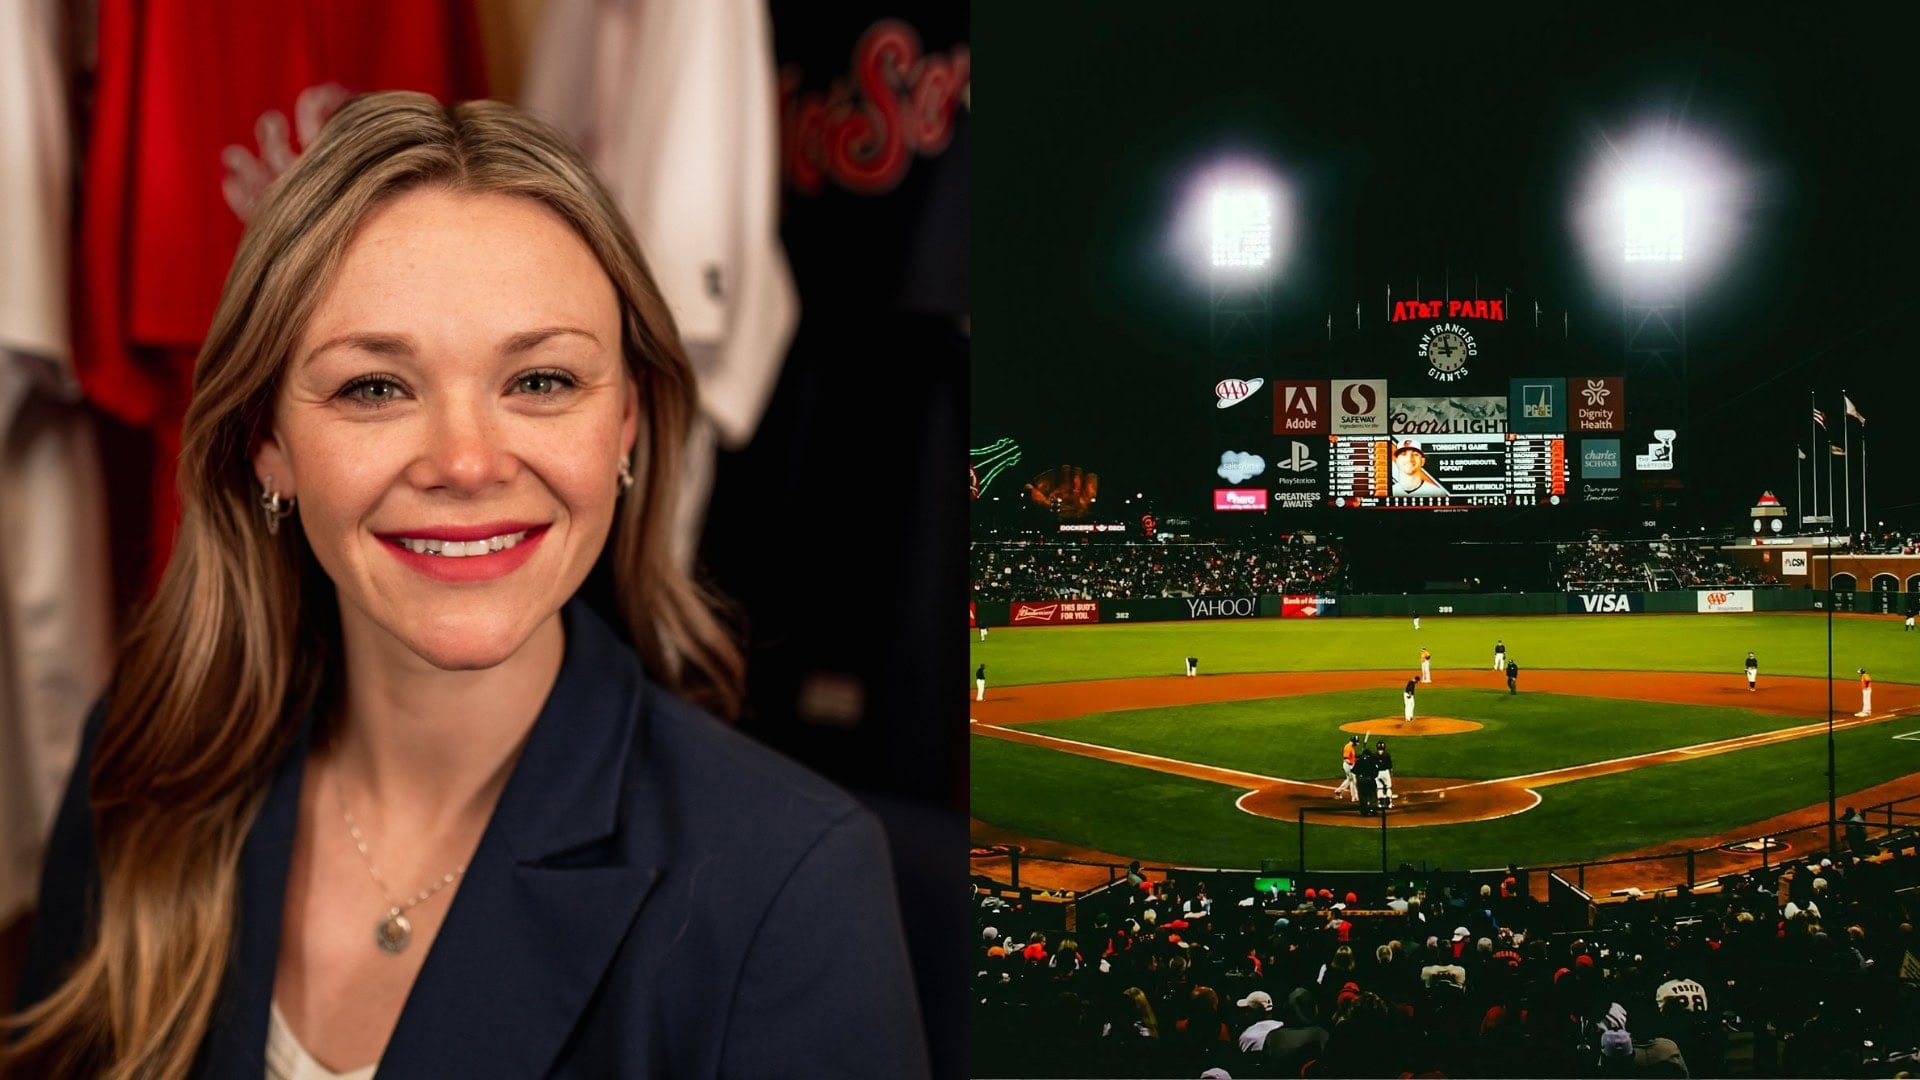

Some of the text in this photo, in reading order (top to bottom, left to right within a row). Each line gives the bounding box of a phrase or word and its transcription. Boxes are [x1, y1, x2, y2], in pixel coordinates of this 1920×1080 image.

[1393, 301, 1504, 322] AT&T PARK
[1418, 323, 1478, 357] SAN FRANCISCO
[1428, 367, 1468, 382] GIANTS
[1525, 405, 1551, 416] PG&E
[1579, 409, 1614, 421] Dignity
[1286, 419, 1317, 429] Adobe
[1391, 412, 1507, 434] Coors LIGHT
[1581, 421, 1613, 429] Health
[1585, 450, 1616, 460] charles
[1279, 478, 1317, 486] PlayStation
[1792, 559, 1804, 567] CSN
[1061, 603, 1096, 612] THIS BUD'S
[1187, 597, 1256, 619] YAHOO!
[1578, 594, 1630, 612] VISA
[1061, 612, 1089, 620] FOR YOU.
[1672, 985, 1699, 994] POSEY
